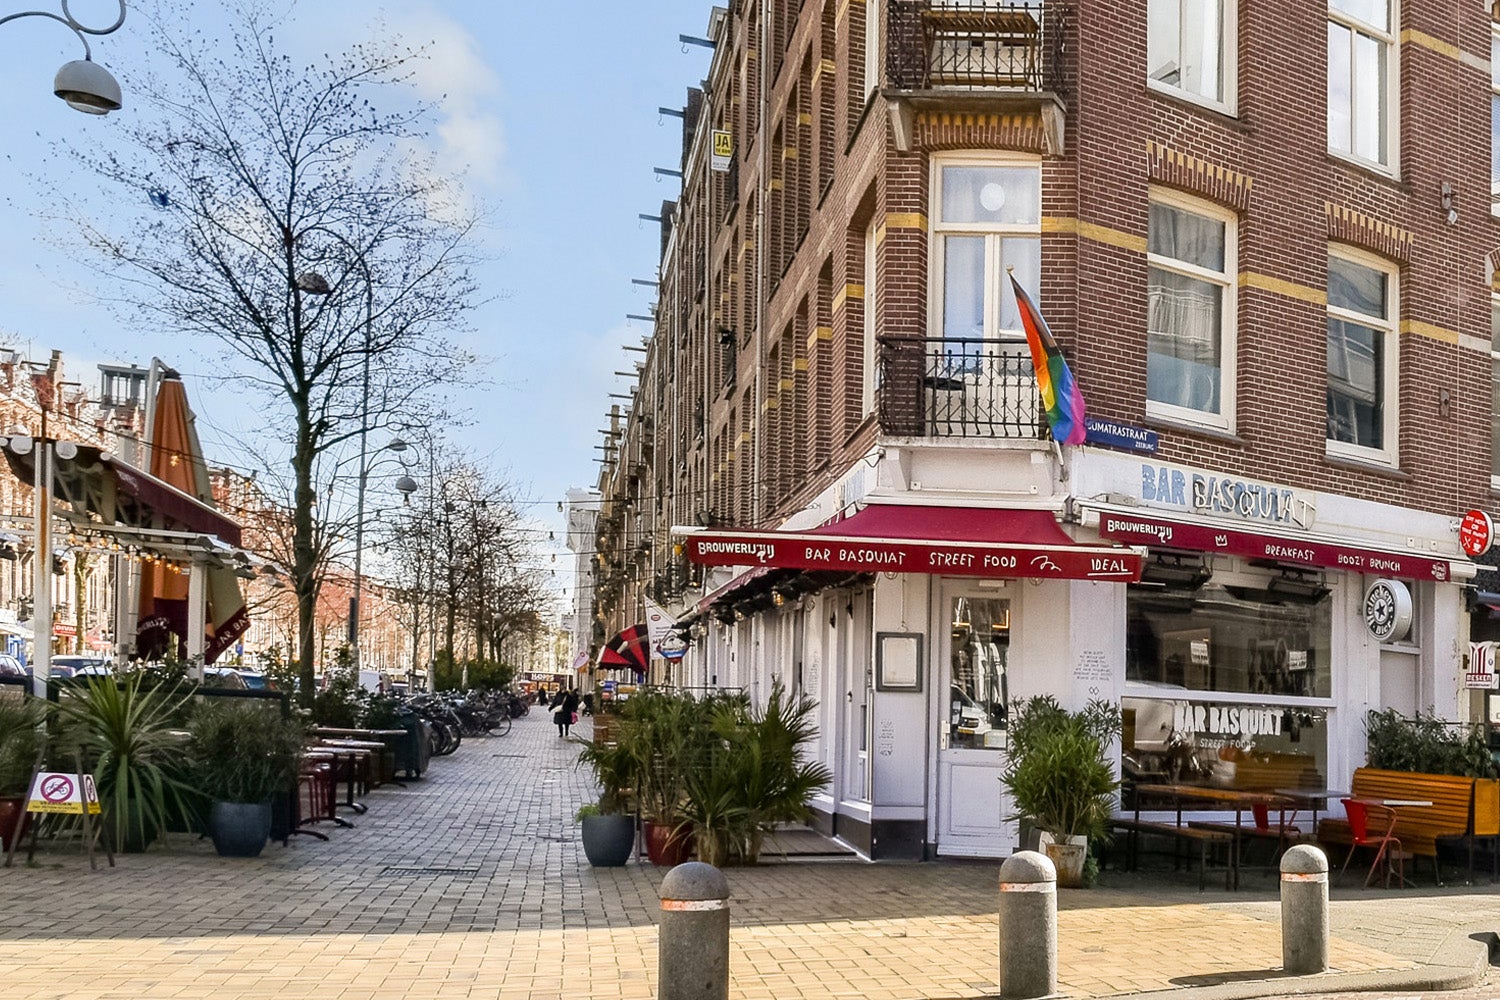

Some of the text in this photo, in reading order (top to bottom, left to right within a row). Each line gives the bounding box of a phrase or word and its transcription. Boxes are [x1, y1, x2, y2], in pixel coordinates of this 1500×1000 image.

[1142, 464, 1186, 505] BAR
[805, 547, 906, 565] BAR BASQUIAT
[929, 552, 1017, 568] STREET FOOD
[1265, 544, 1315, 561] BREAKFAST
[1091, 558, 1128, 572] IDEAL
[1338, 554, 1401, 572] BOOZY BRUNCH
[1174, 705, 1285, 736] BAR BASQUIAT
[1200, 738, 1226, 749] STREET
